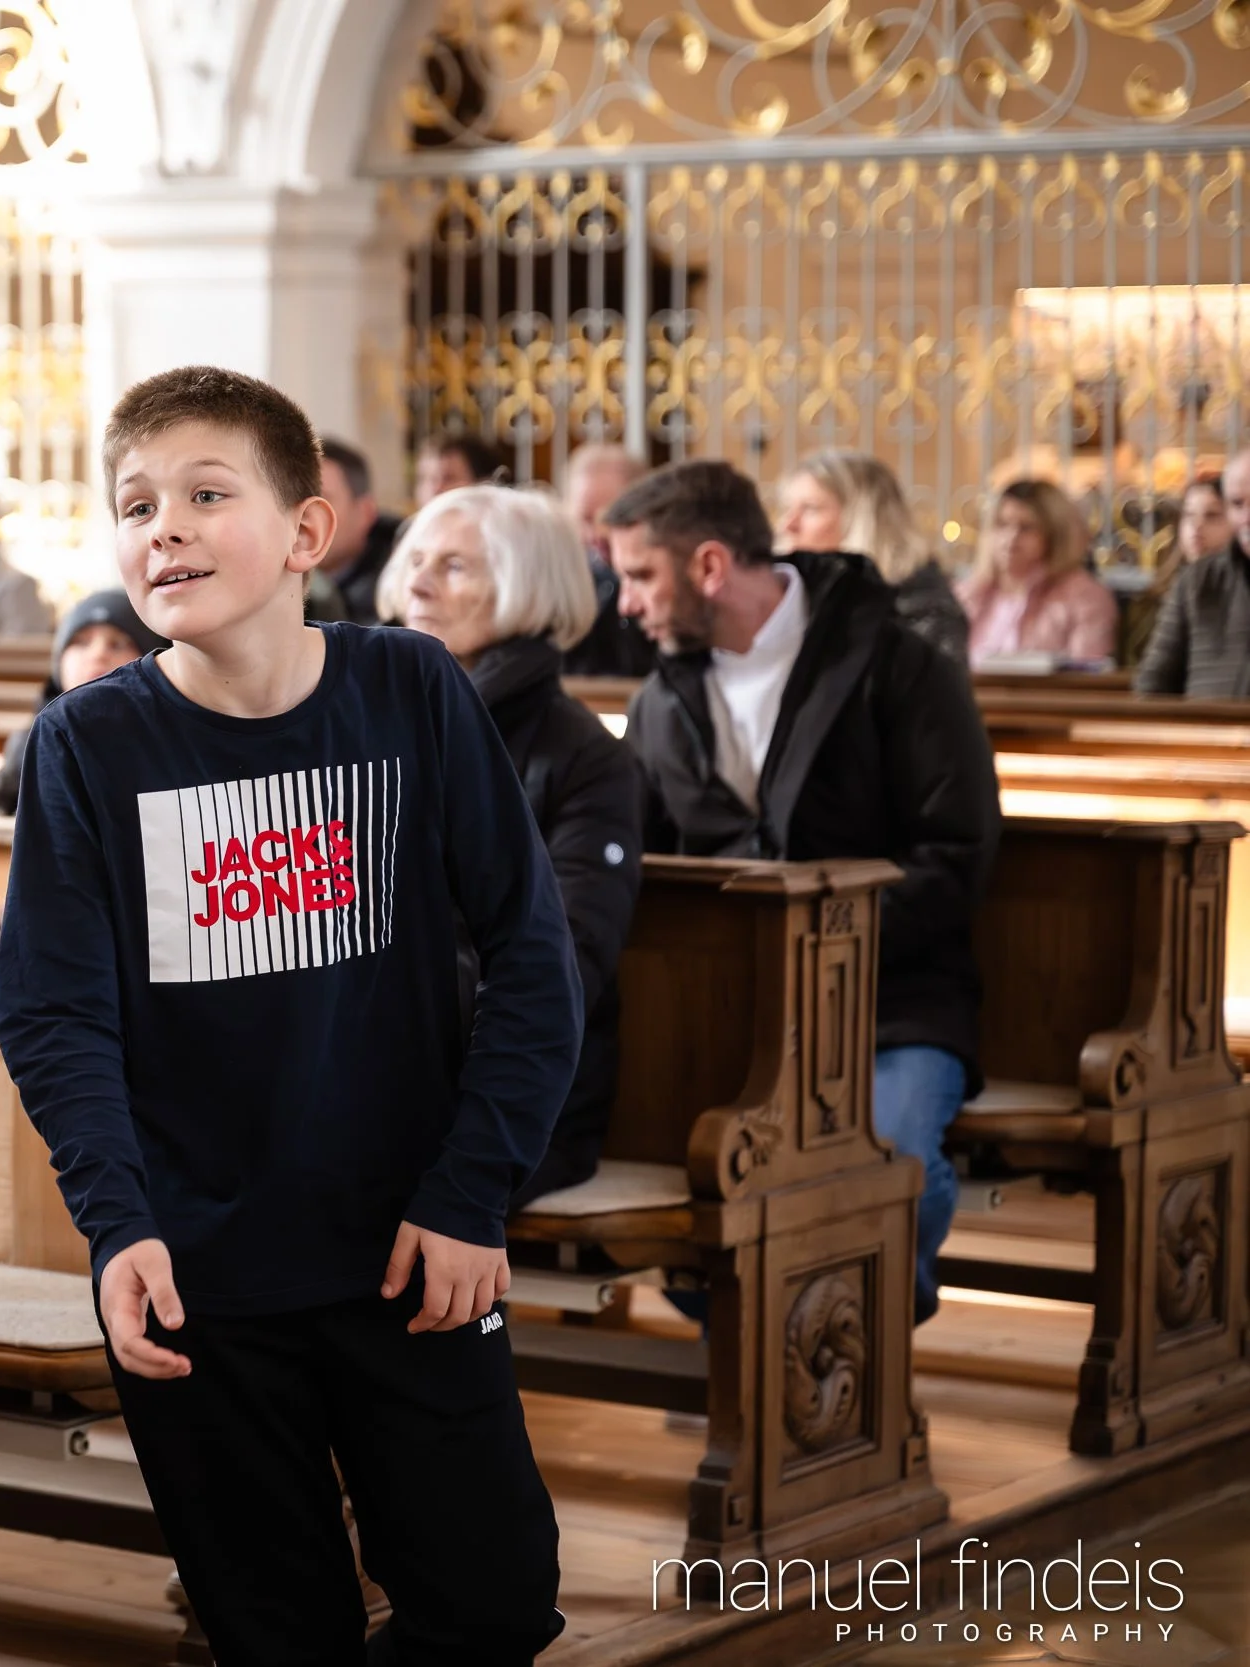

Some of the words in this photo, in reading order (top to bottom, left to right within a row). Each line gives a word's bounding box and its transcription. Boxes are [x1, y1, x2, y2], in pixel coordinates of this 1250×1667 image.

[190, 819, 354, 886] JACK&
[193, 863, 357, 928] JONES
[480, 1311, 504, 1335] JAKO
